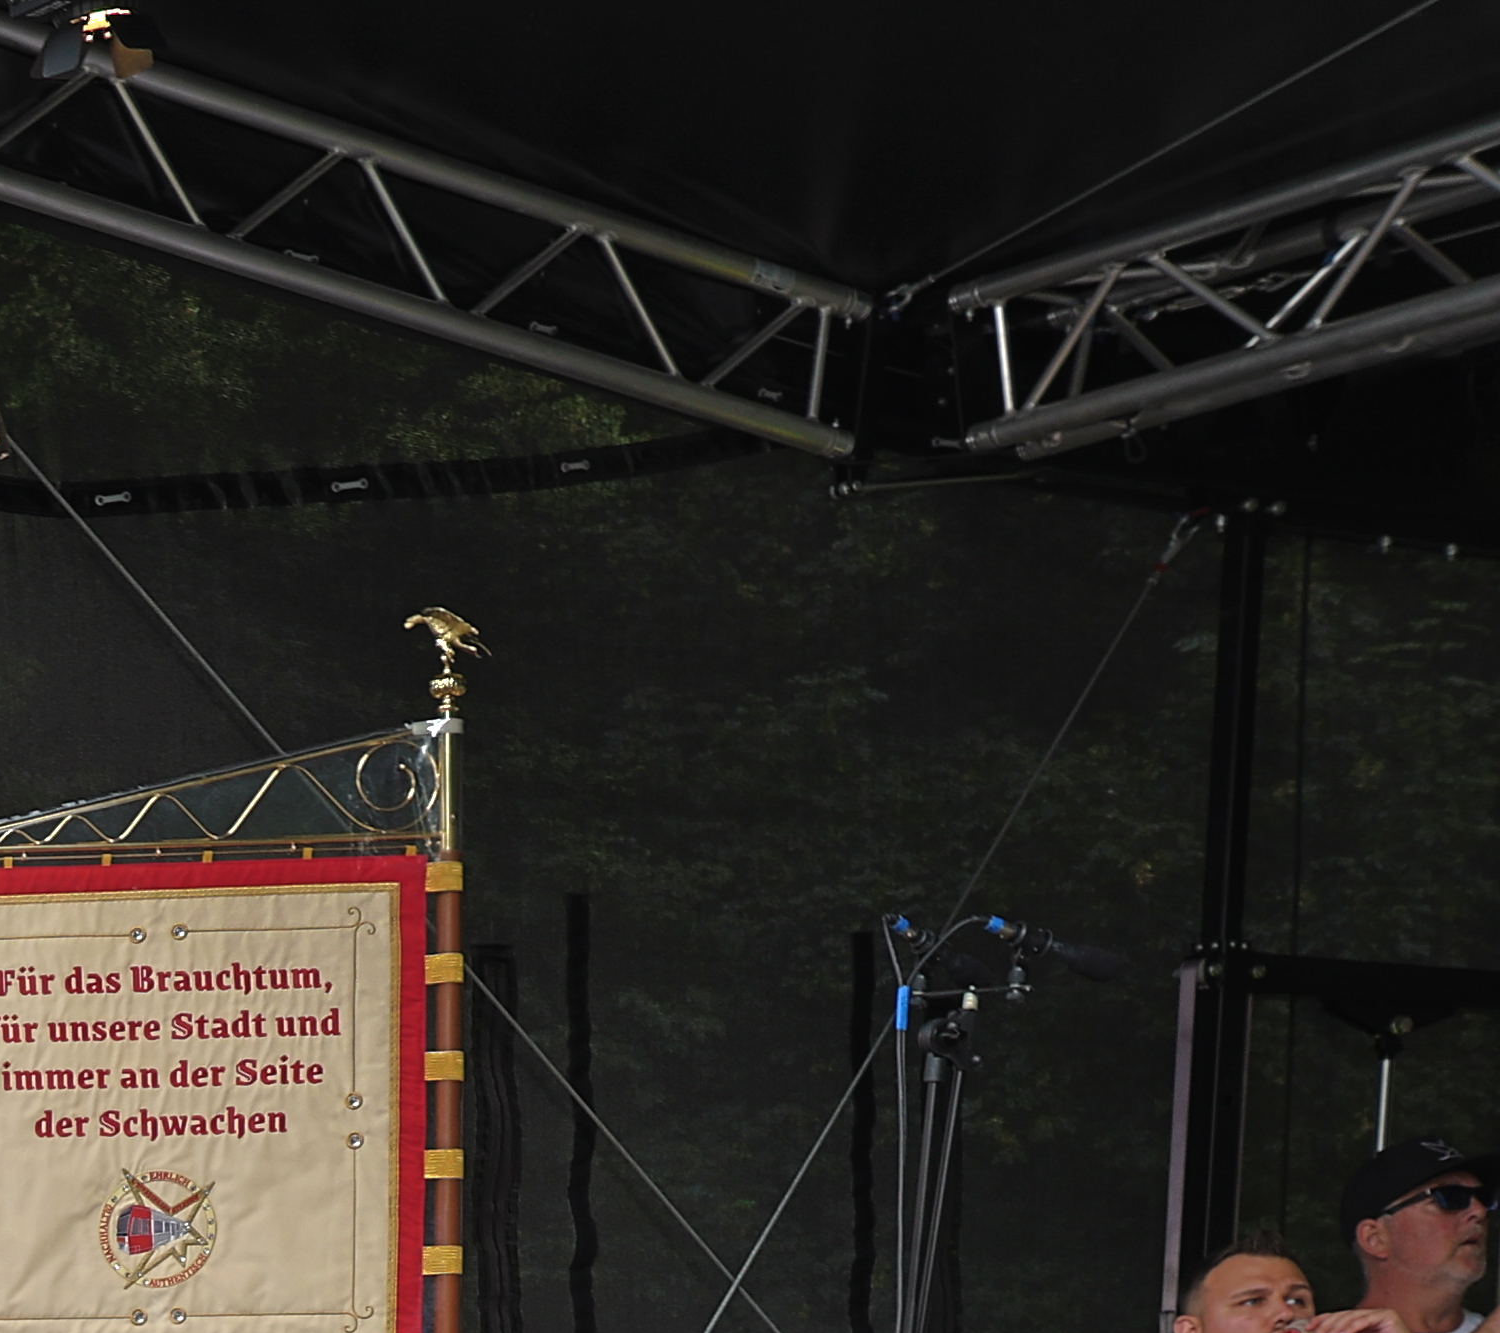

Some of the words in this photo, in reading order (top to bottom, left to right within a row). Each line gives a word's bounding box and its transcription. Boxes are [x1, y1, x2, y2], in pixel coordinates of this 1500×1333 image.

[64, 966, 122, 995] das
[130, 962, 333, 995] Brauchtum,
[47, 1018, 161, 1043] unsere
[171, 1009, 268, 1040] Stadt
[275, 1008, 341, 1037] und
[2, 1061, 111, 1091] immer
[120, 1067, 160, 1090] an
[169, 1060, 226, 1088] der
[235, 1054, 324, 1087] Seite
[34, 1110, 90, 1138] der
[99, 1106, 288, 1142] Schwachen
